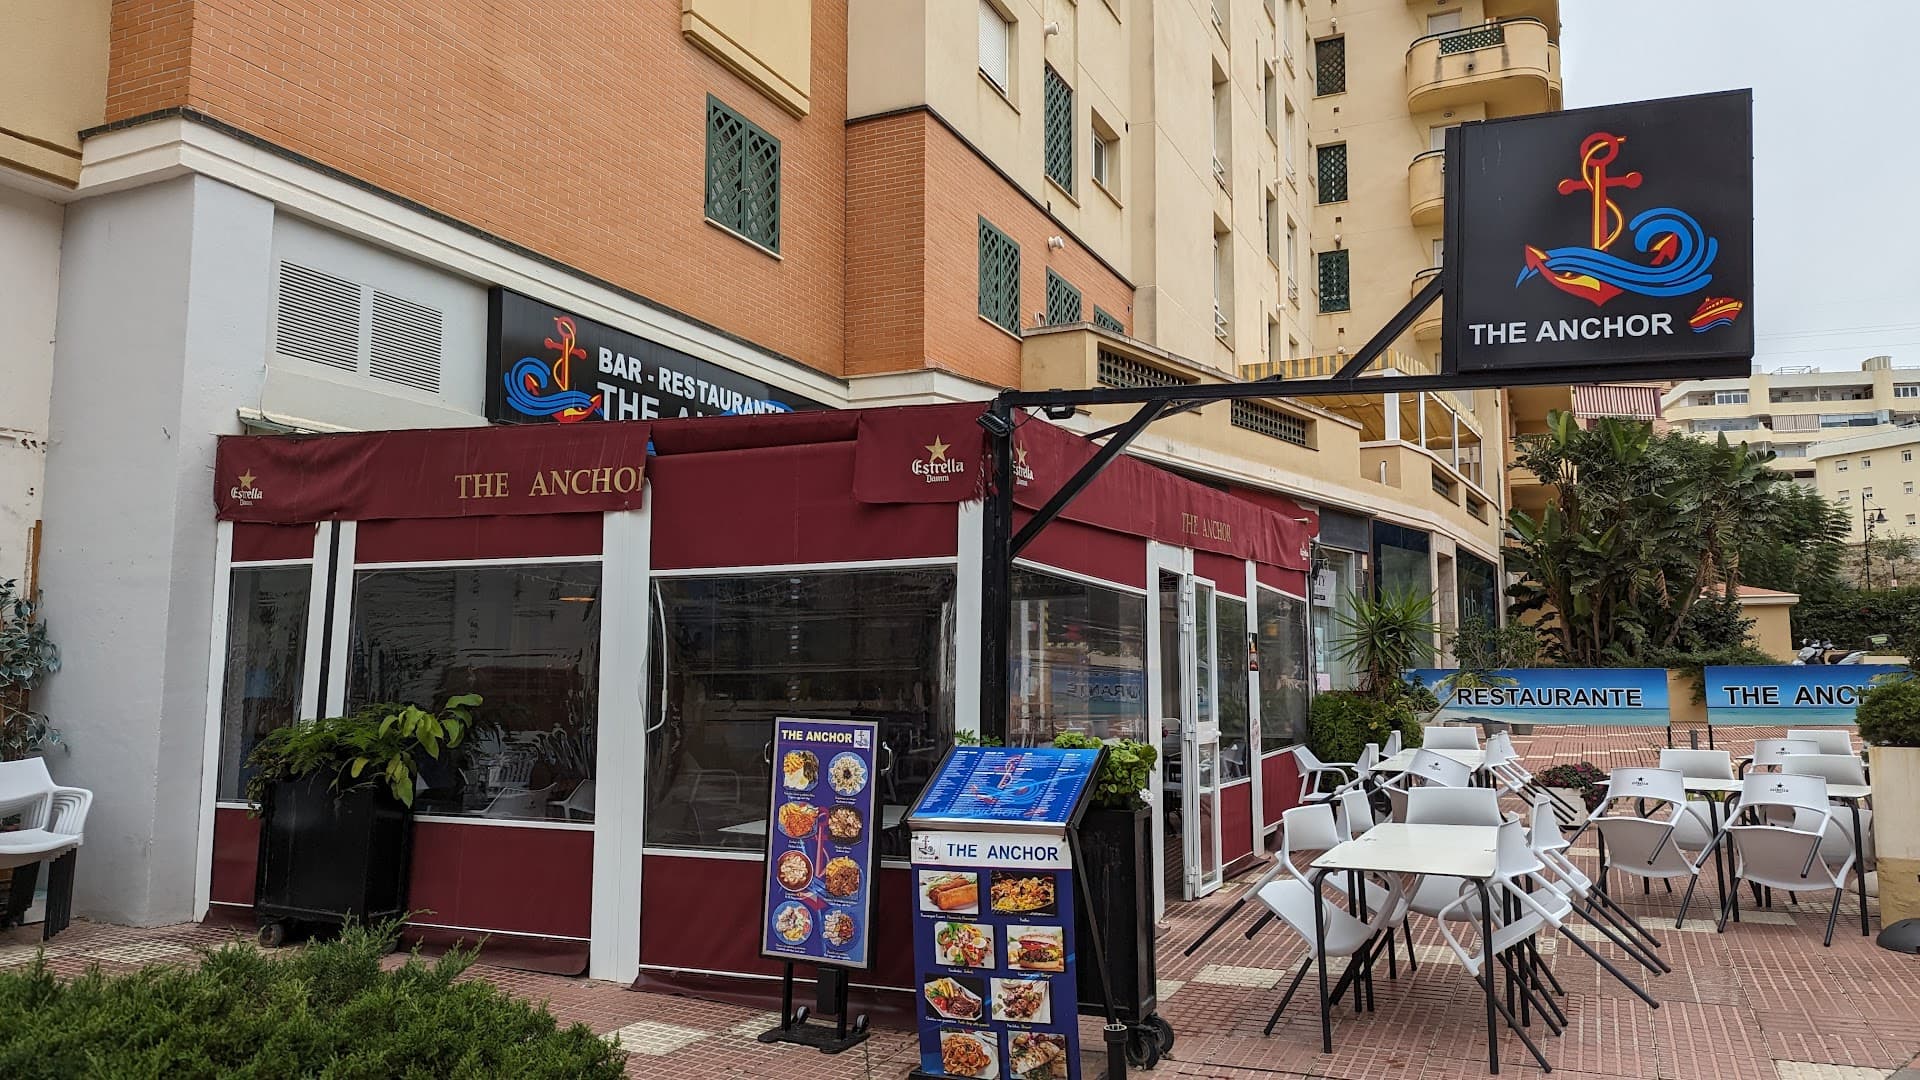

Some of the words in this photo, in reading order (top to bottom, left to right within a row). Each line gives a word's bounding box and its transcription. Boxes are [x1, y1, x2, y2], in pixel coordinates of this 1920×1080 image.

[1469, 321, 1527, 345] THE
[1535, 313, 1674, 342] ANCHOR
[599, 346, 643, 384] BAR
[597, 381, 660, 421] THE
[912, 458, 964, 475] Estrella
[454, 473, 510, 499] THE
[926, 474, 950, 483] Damm
[230, 486, 263, 499] Estrella
[1181, 511, 1198, 535] THE
[1202, 518, 1232, 543] ANCHOR
[1456, 687, 1643, 707] RESTAURANTE
[1723, 686, 1780, 705] THE
[781, 729, 804, 741] THE
[806, 731, 853, 744] ANCHOR
[946, 843, 978, 858] THE
[987, 845, 1059, 861] ANCHOR
